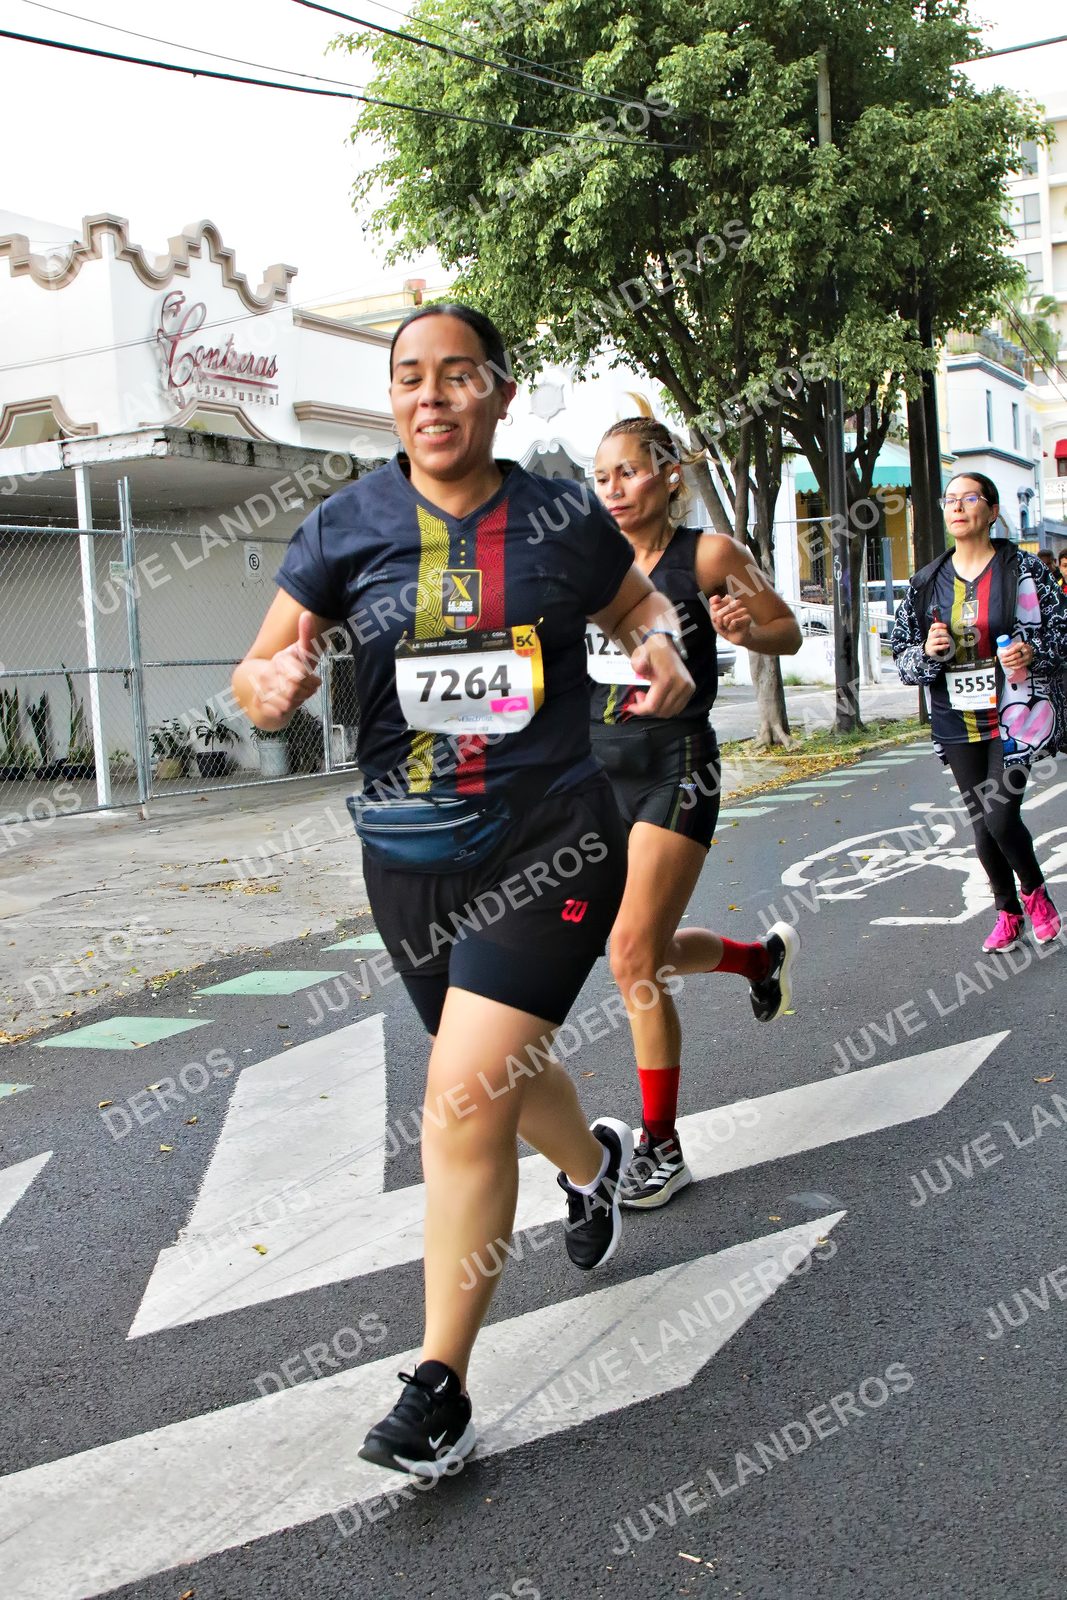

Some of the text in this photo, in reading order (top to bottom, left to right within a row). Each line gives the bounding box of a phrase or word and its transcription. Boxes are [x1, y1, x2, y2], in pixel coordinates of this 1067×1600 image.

[412, 641, 438, 649] LENES
[584, 632, 623, 656] 12
[416, 664, 511, 703] 7264
[955, 674, 997, 694] 5555
